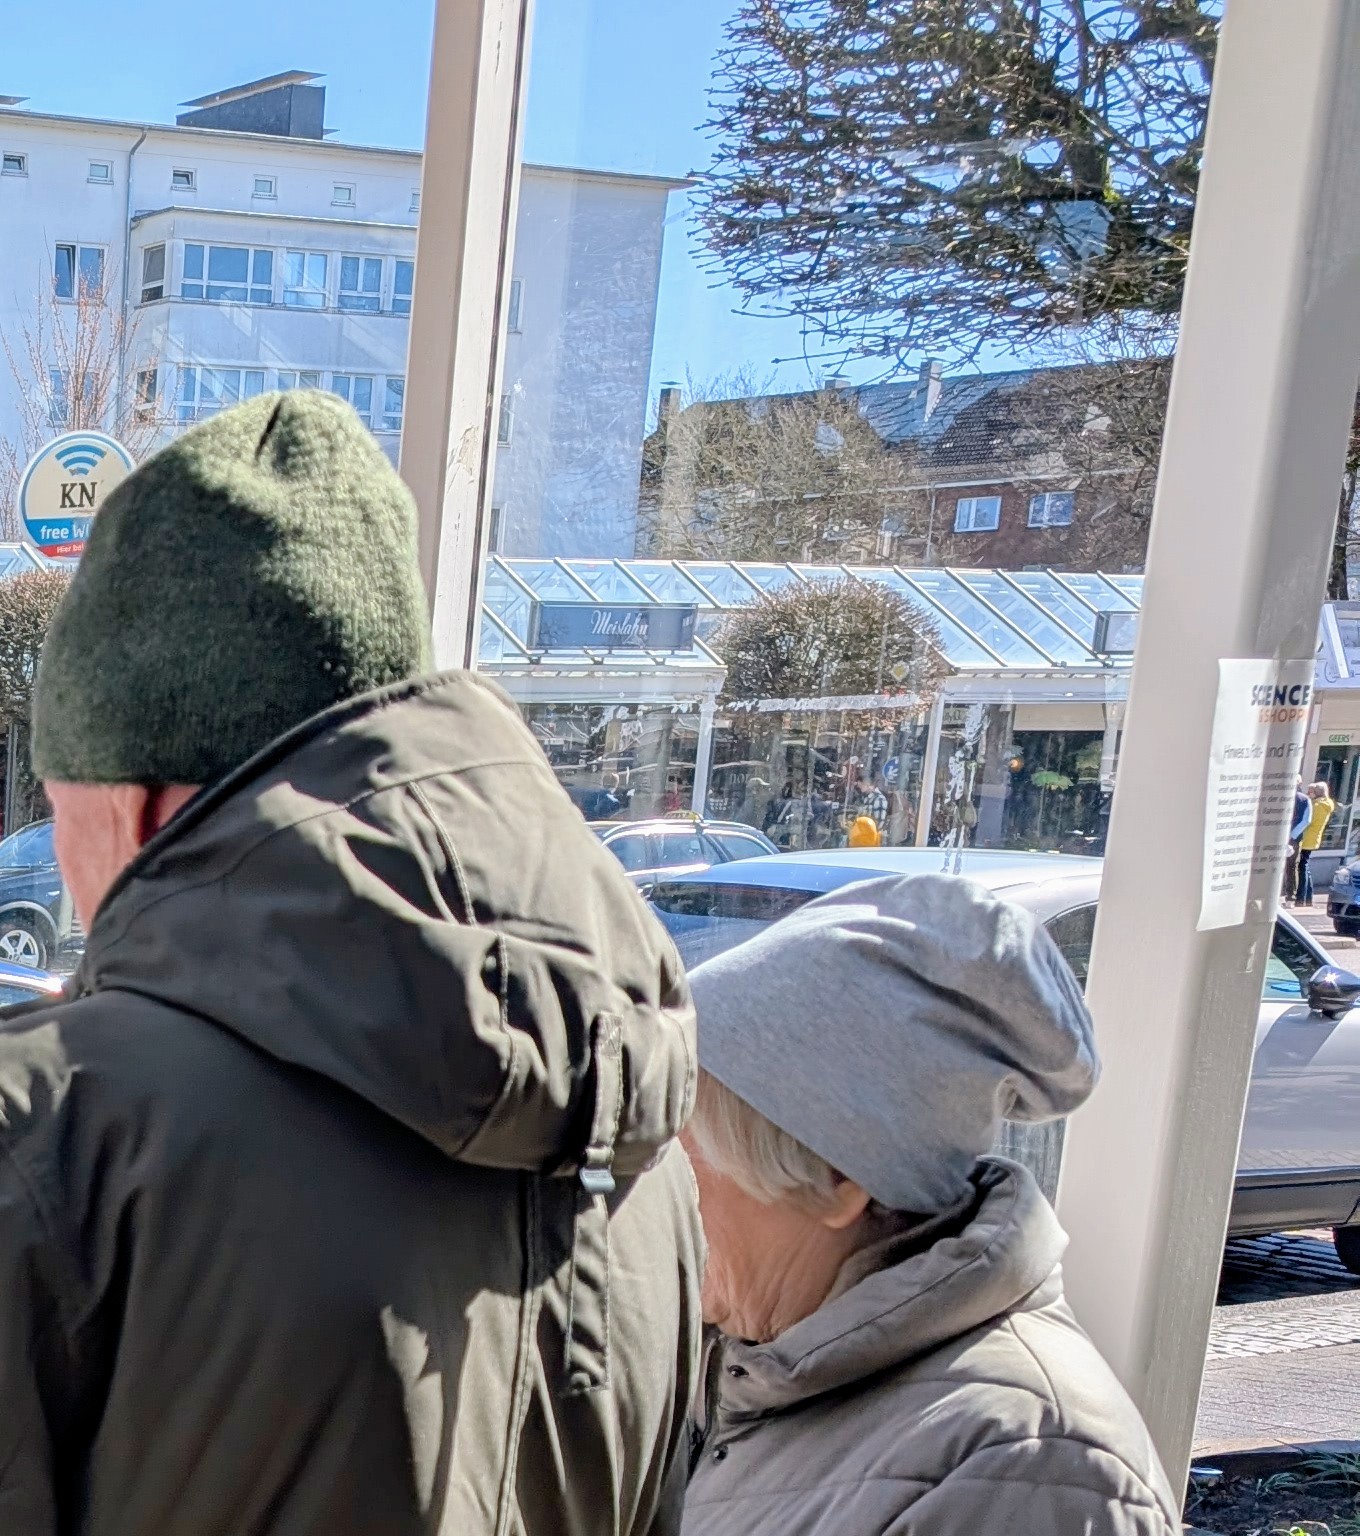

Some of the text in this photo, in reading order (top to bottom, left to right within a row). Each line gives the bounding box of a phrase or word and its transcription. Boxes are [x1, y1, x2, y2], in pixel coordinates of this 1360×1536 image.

[60, 482, 97, 508] KN
[41, 526, 69, 539] free
[1329, 735, 1350, 743] GEERS
